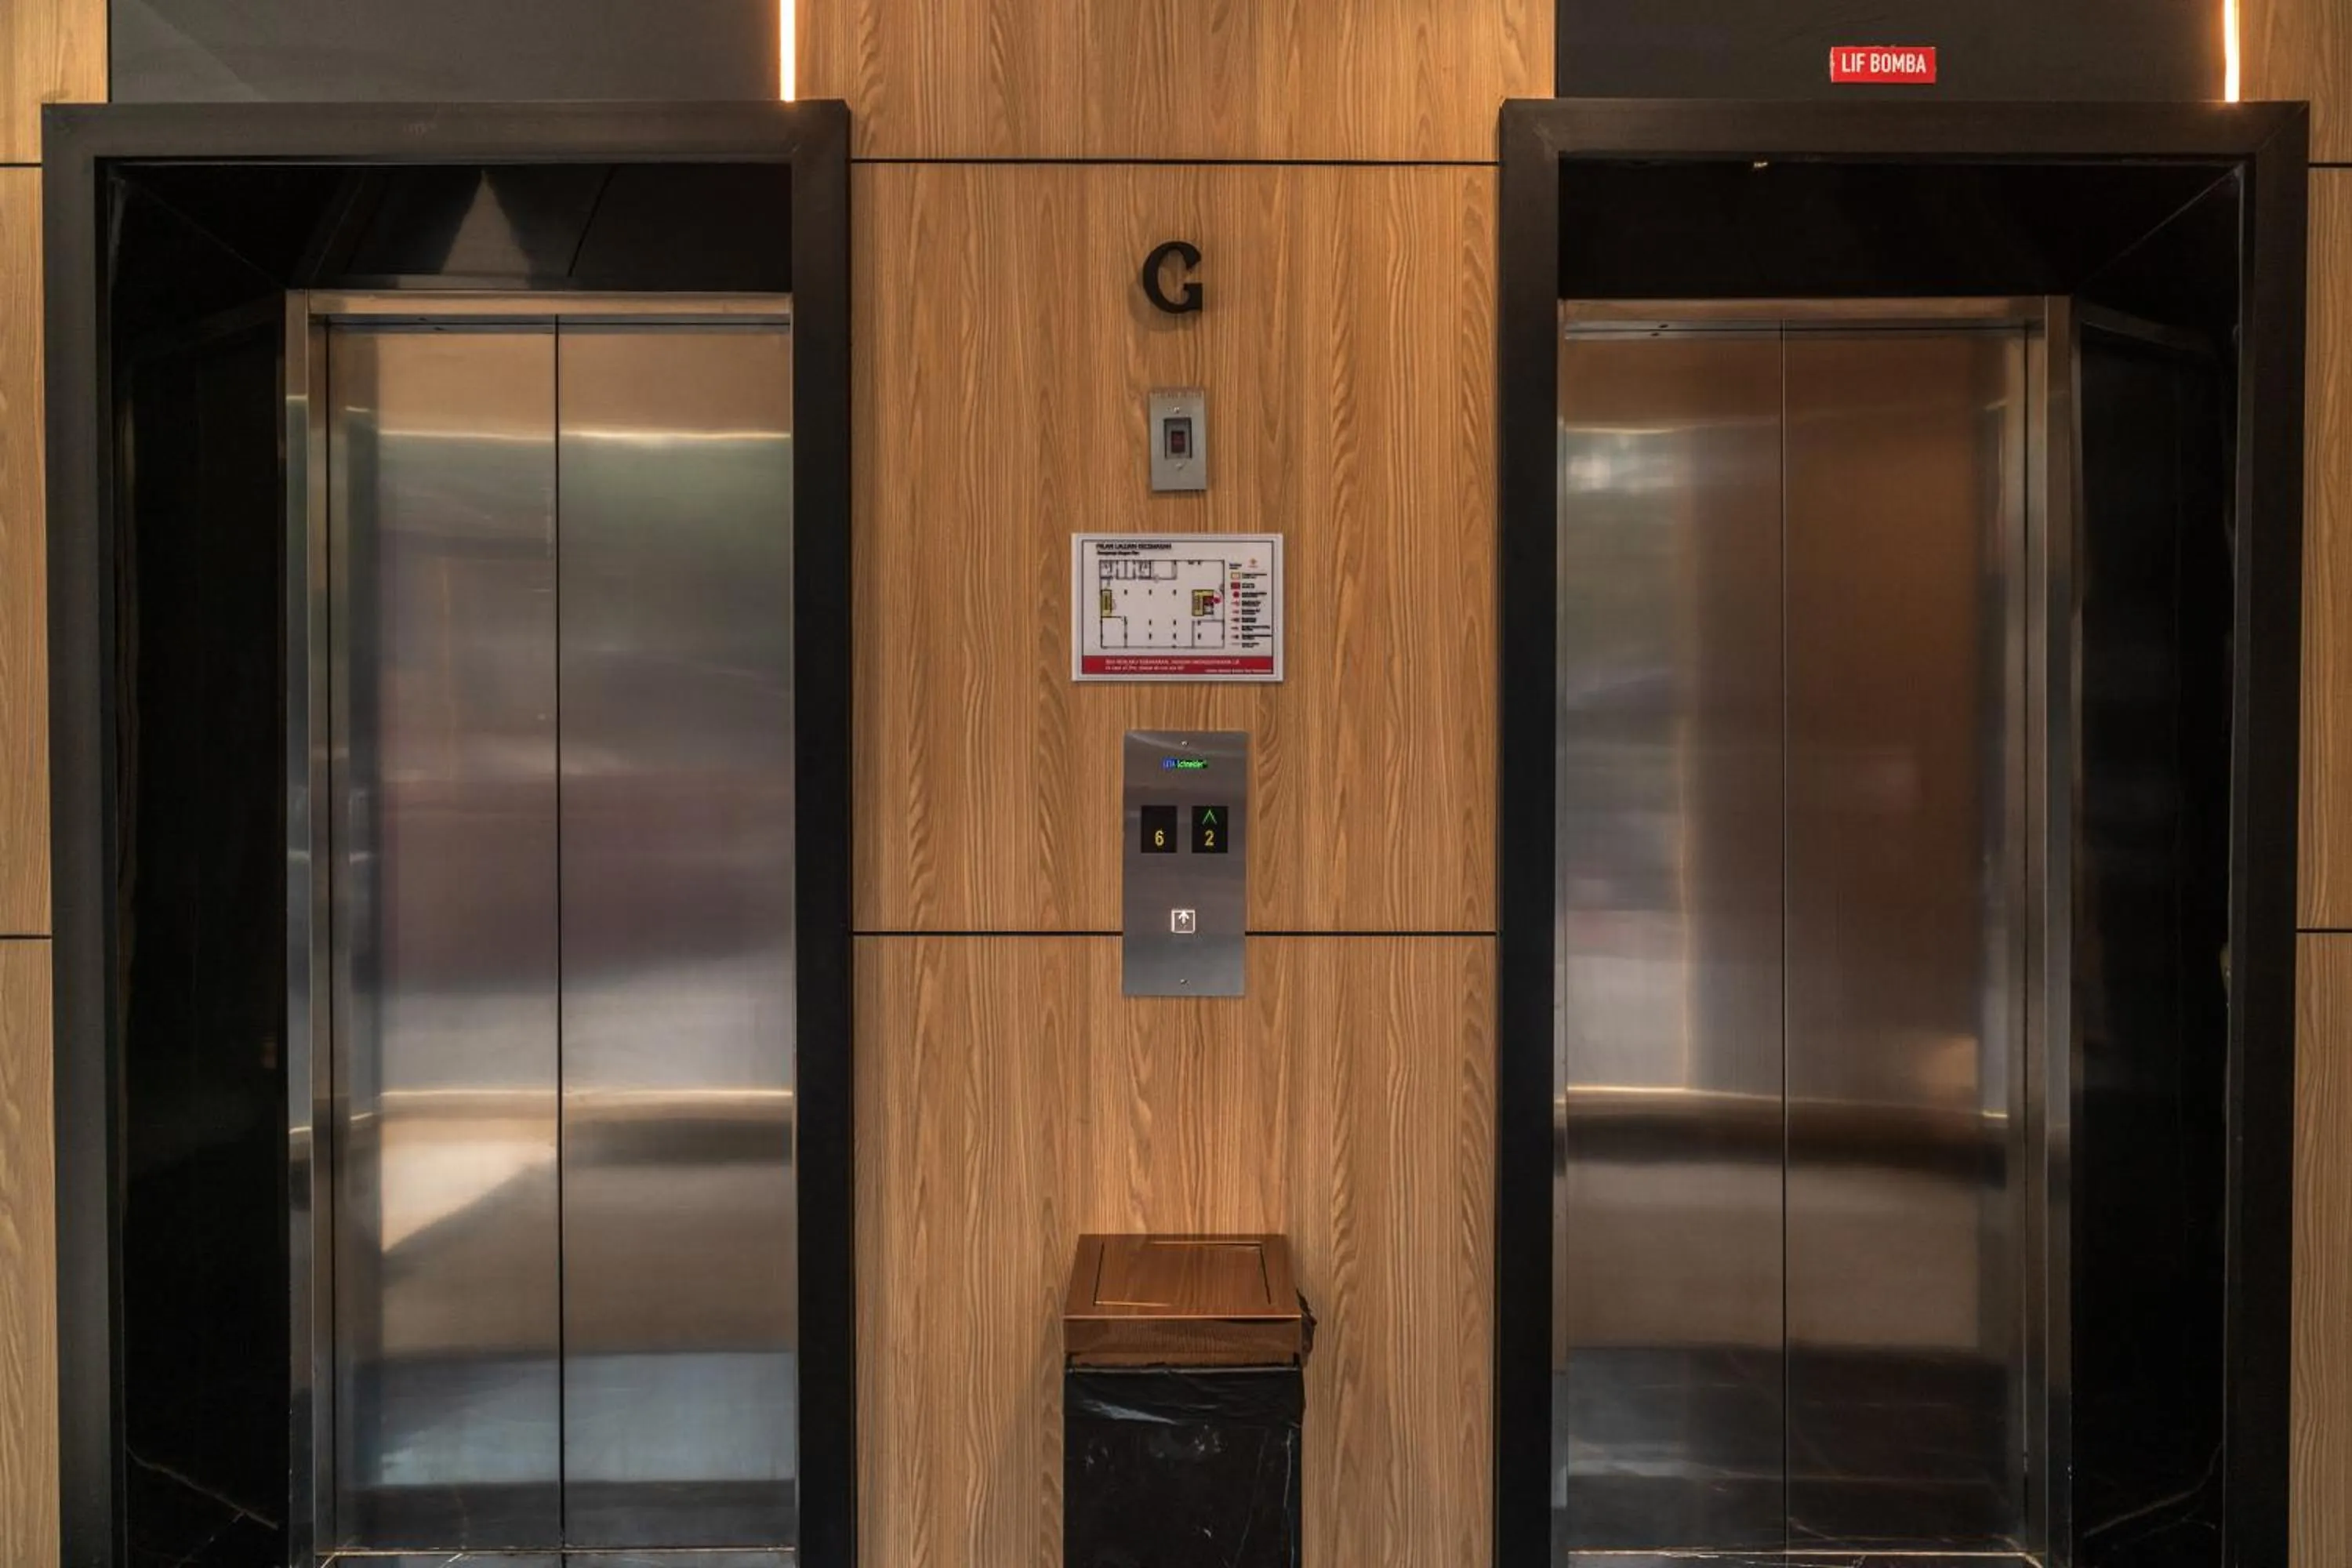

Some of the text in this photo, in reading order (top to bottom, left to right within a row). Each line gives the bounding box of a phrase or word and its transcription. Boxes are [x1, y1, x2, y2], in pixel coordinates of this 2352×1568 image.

[1842, 53, 1926, 74] LIF BOMBA
[1142, 241, 1203, 314] G
[1154, 830, 1165, 847] 6
[1204, 830, 1215, 847] 2
